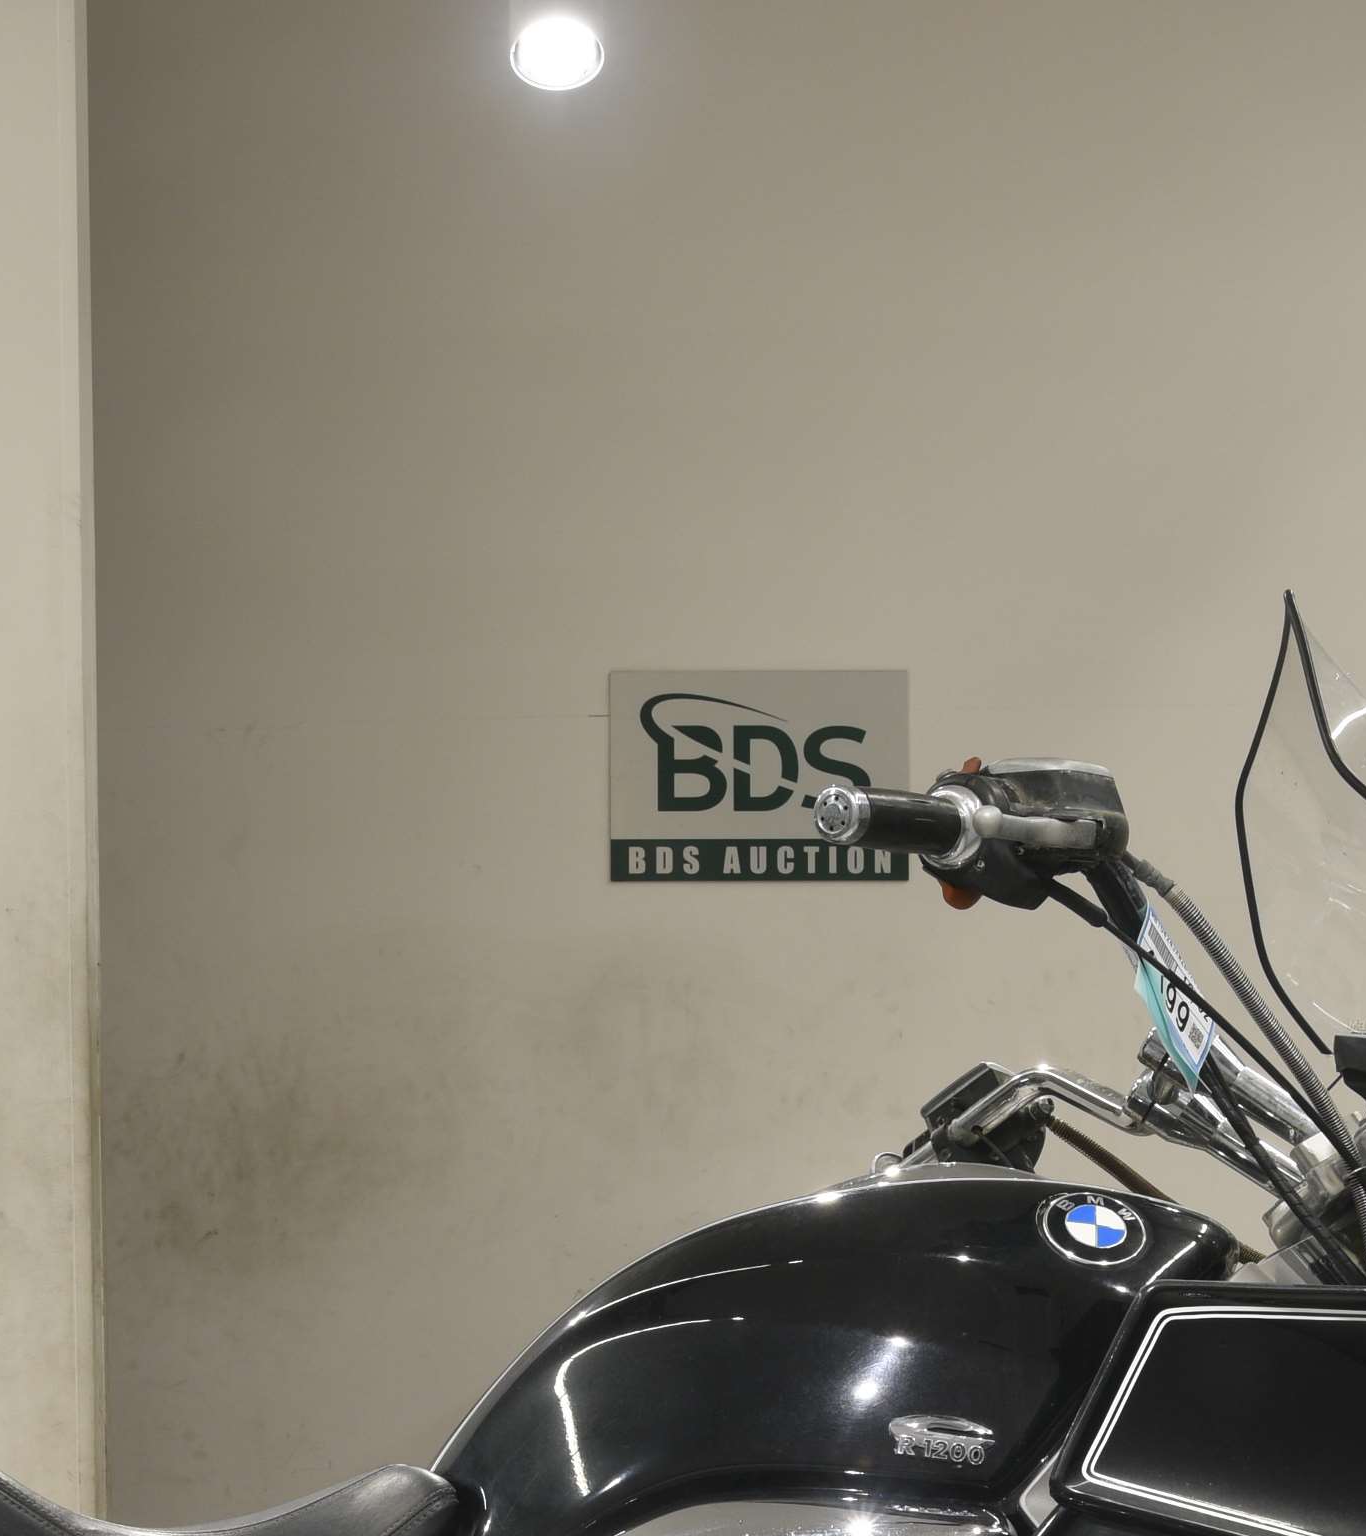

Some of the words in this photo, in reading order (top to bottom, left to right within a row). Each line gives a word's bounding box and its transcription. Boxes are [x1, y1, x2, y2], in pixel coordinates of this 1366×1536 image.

[640, 693, 871, 812] BDS
[629, 846, 700, 875] BDS
[723, 846, 892, 875] AUCTION
[1056, 1195, 1136, 1221] BMW
[895, 1435, 915, 1456] R
[924, 1438, 985, 1465] 1200
